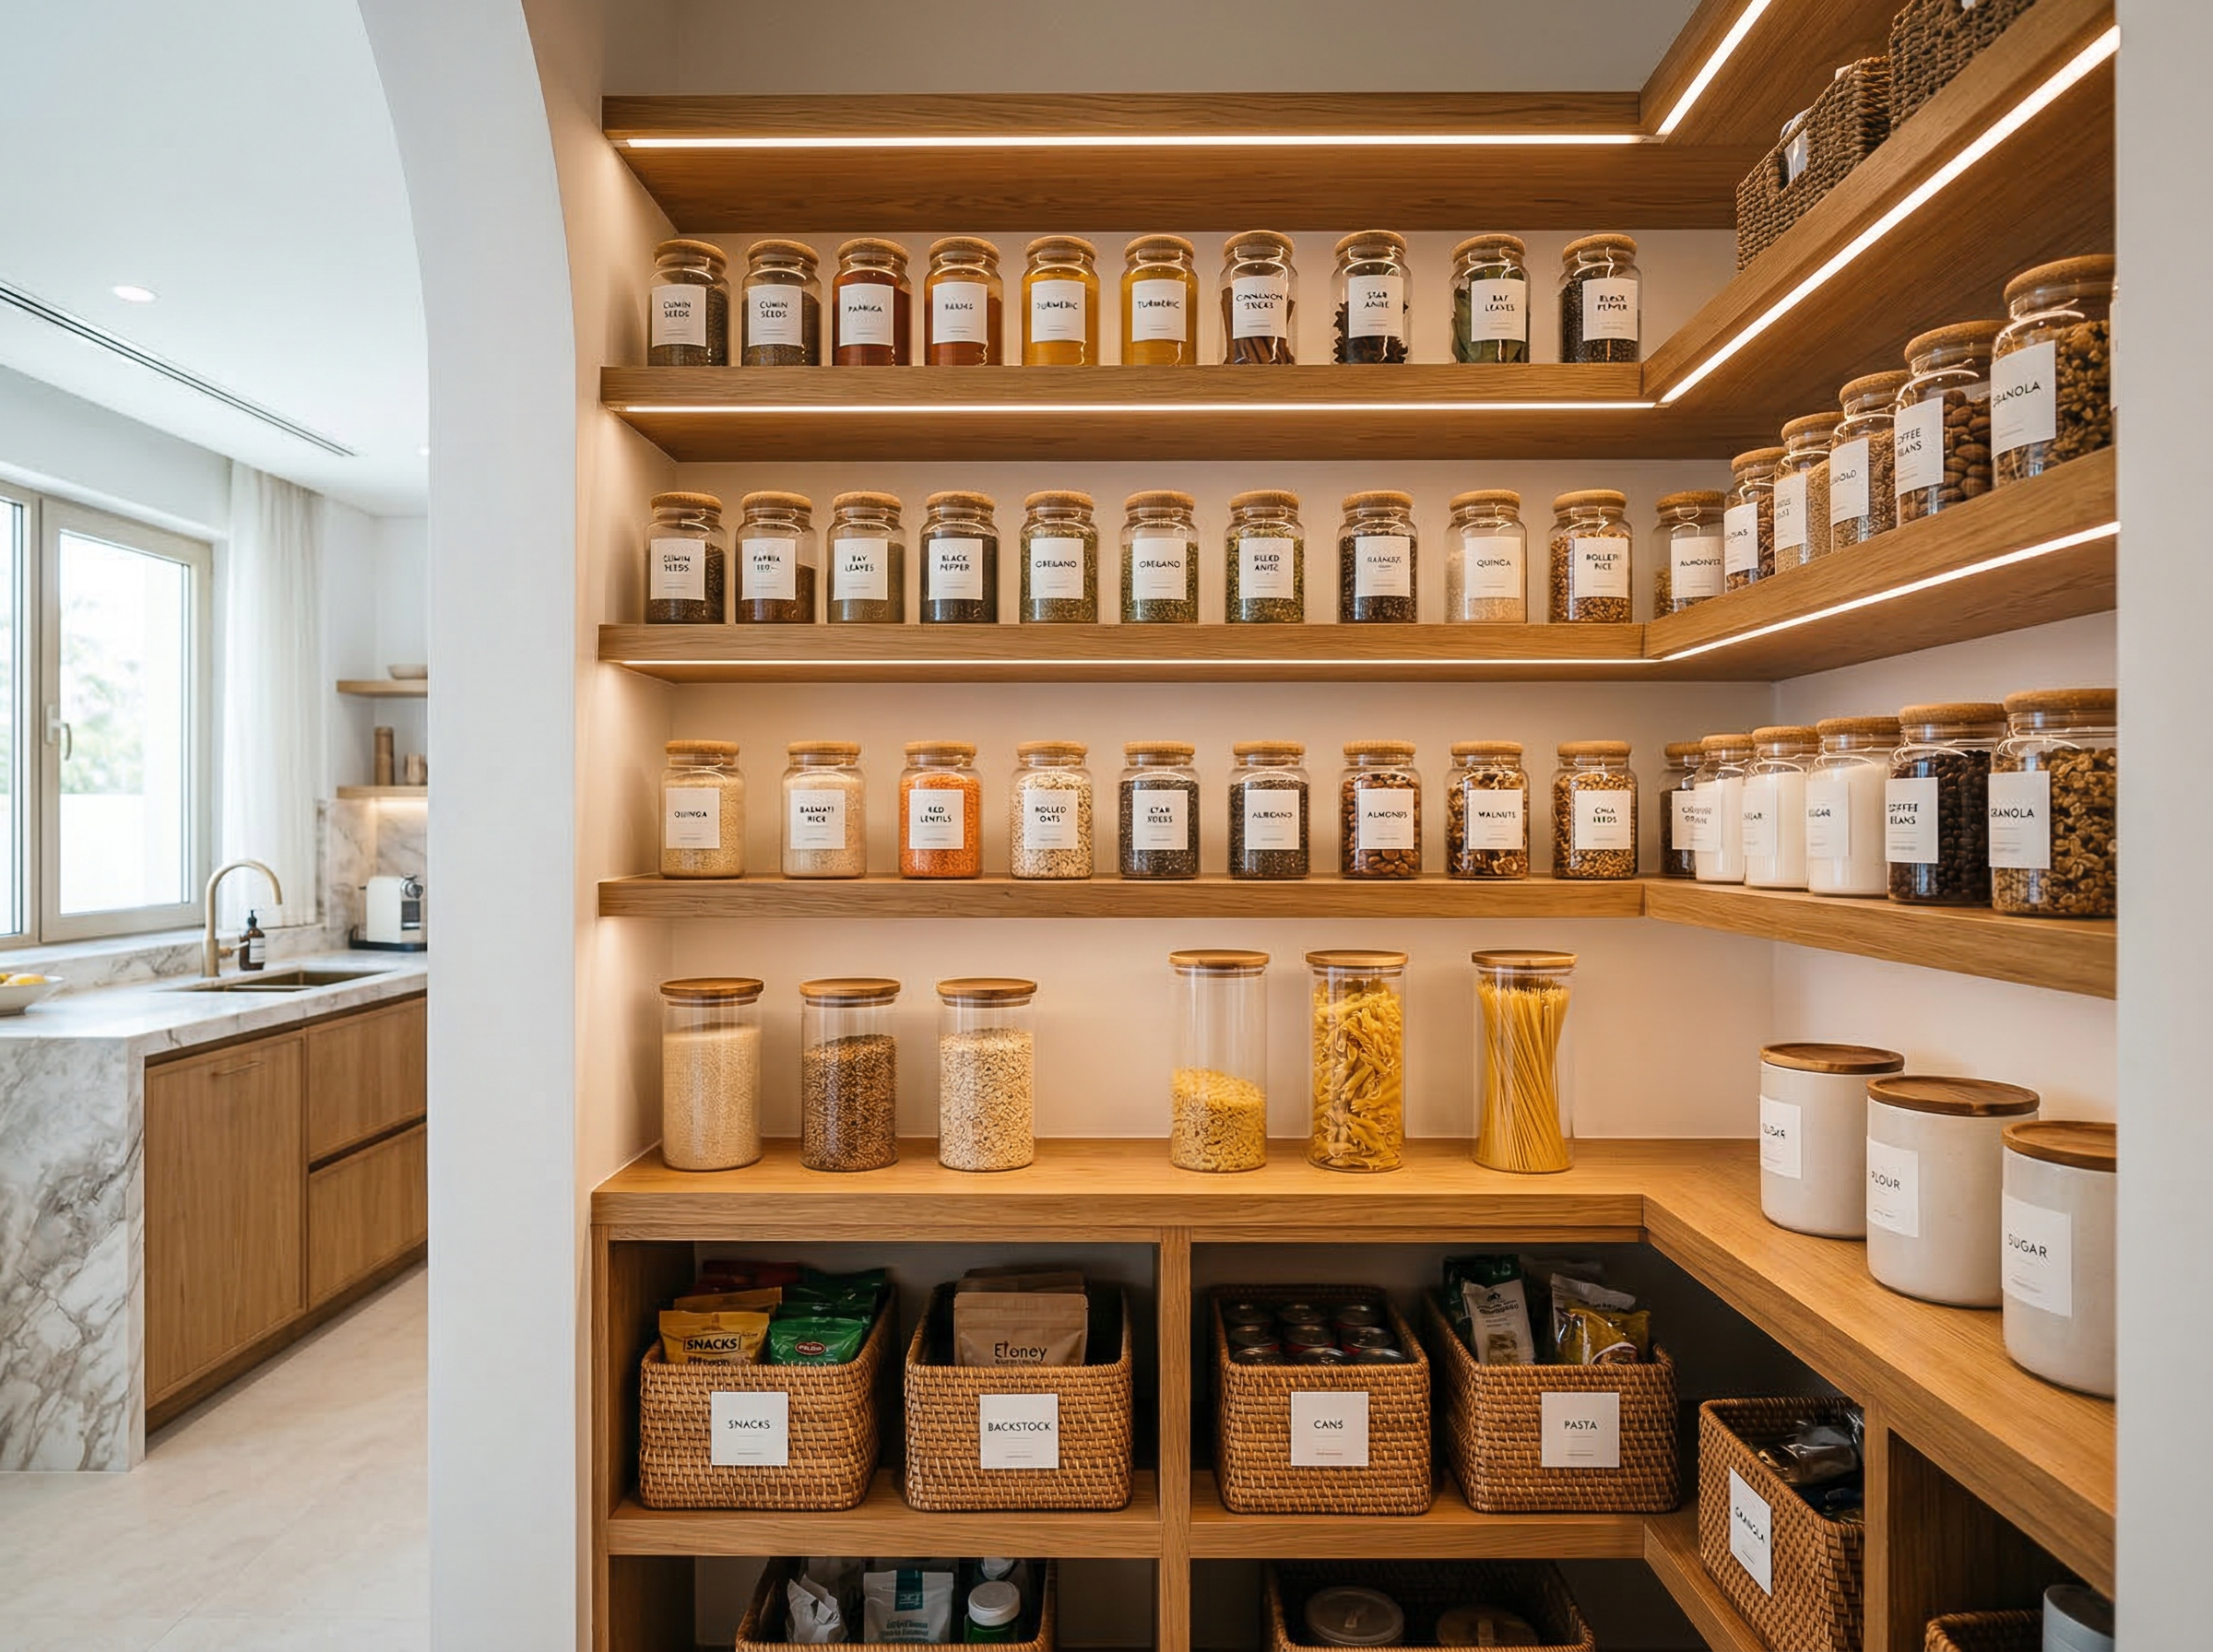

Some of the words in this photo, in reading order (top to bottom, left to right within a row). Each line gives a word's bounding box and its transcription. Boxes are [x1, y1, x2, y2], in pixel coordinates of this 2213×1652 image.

[2007, 1233, 2049, 1259] SUGAR
[685, 1338, 738, 1351] SNACKS
[728, 1419, 771, 1429] SNACKS
[987, 1422, 1051, 1432] BACKSTOCK
[1313, 1420, 1343, 1430] CANS
[1564, 1420, 1598, 1430] PASTA
